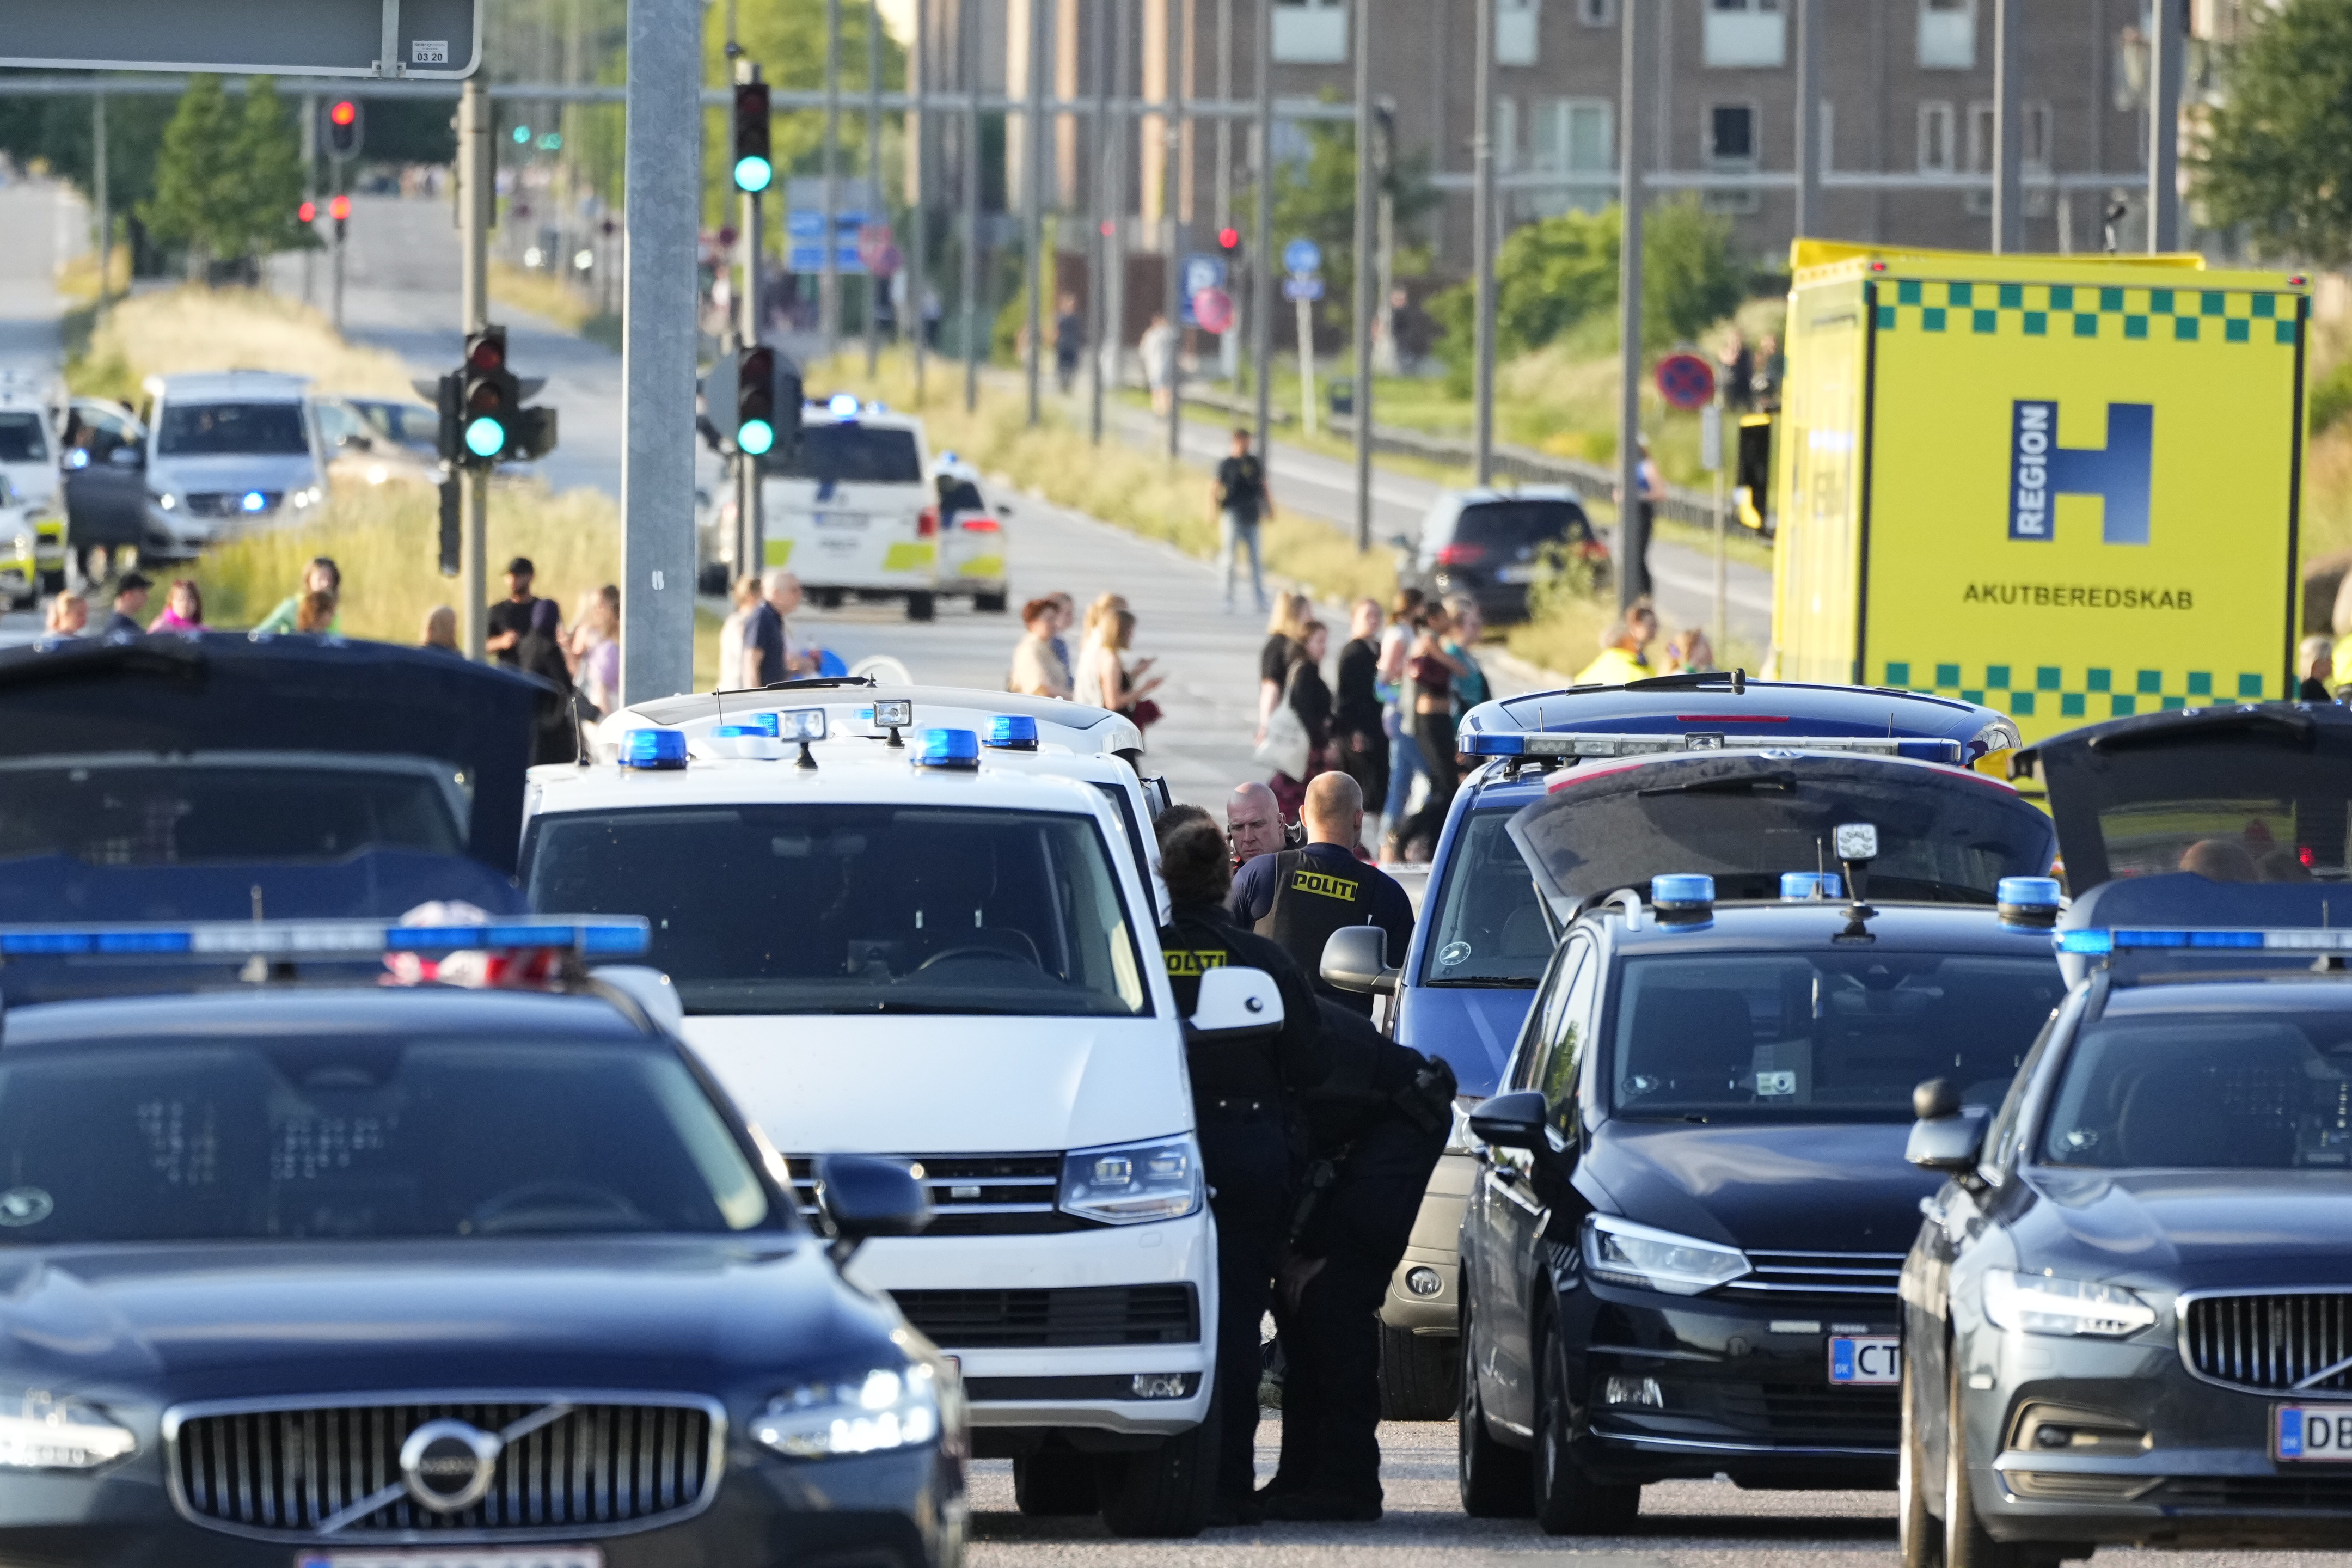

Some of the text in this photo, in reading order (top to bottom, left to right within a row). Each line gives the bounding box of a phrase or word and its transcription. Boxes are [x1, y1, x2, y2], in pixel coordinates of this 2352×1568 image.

[2008, 400, 2153, 546] H
[2016, 405, 2049, 535] REGION
[1963, 583, 2194, 610] AKUTBEREDSKAB
[1293, 873, 1356, 898] POLITI
[1858, 1345, 1899, 1375] CT
